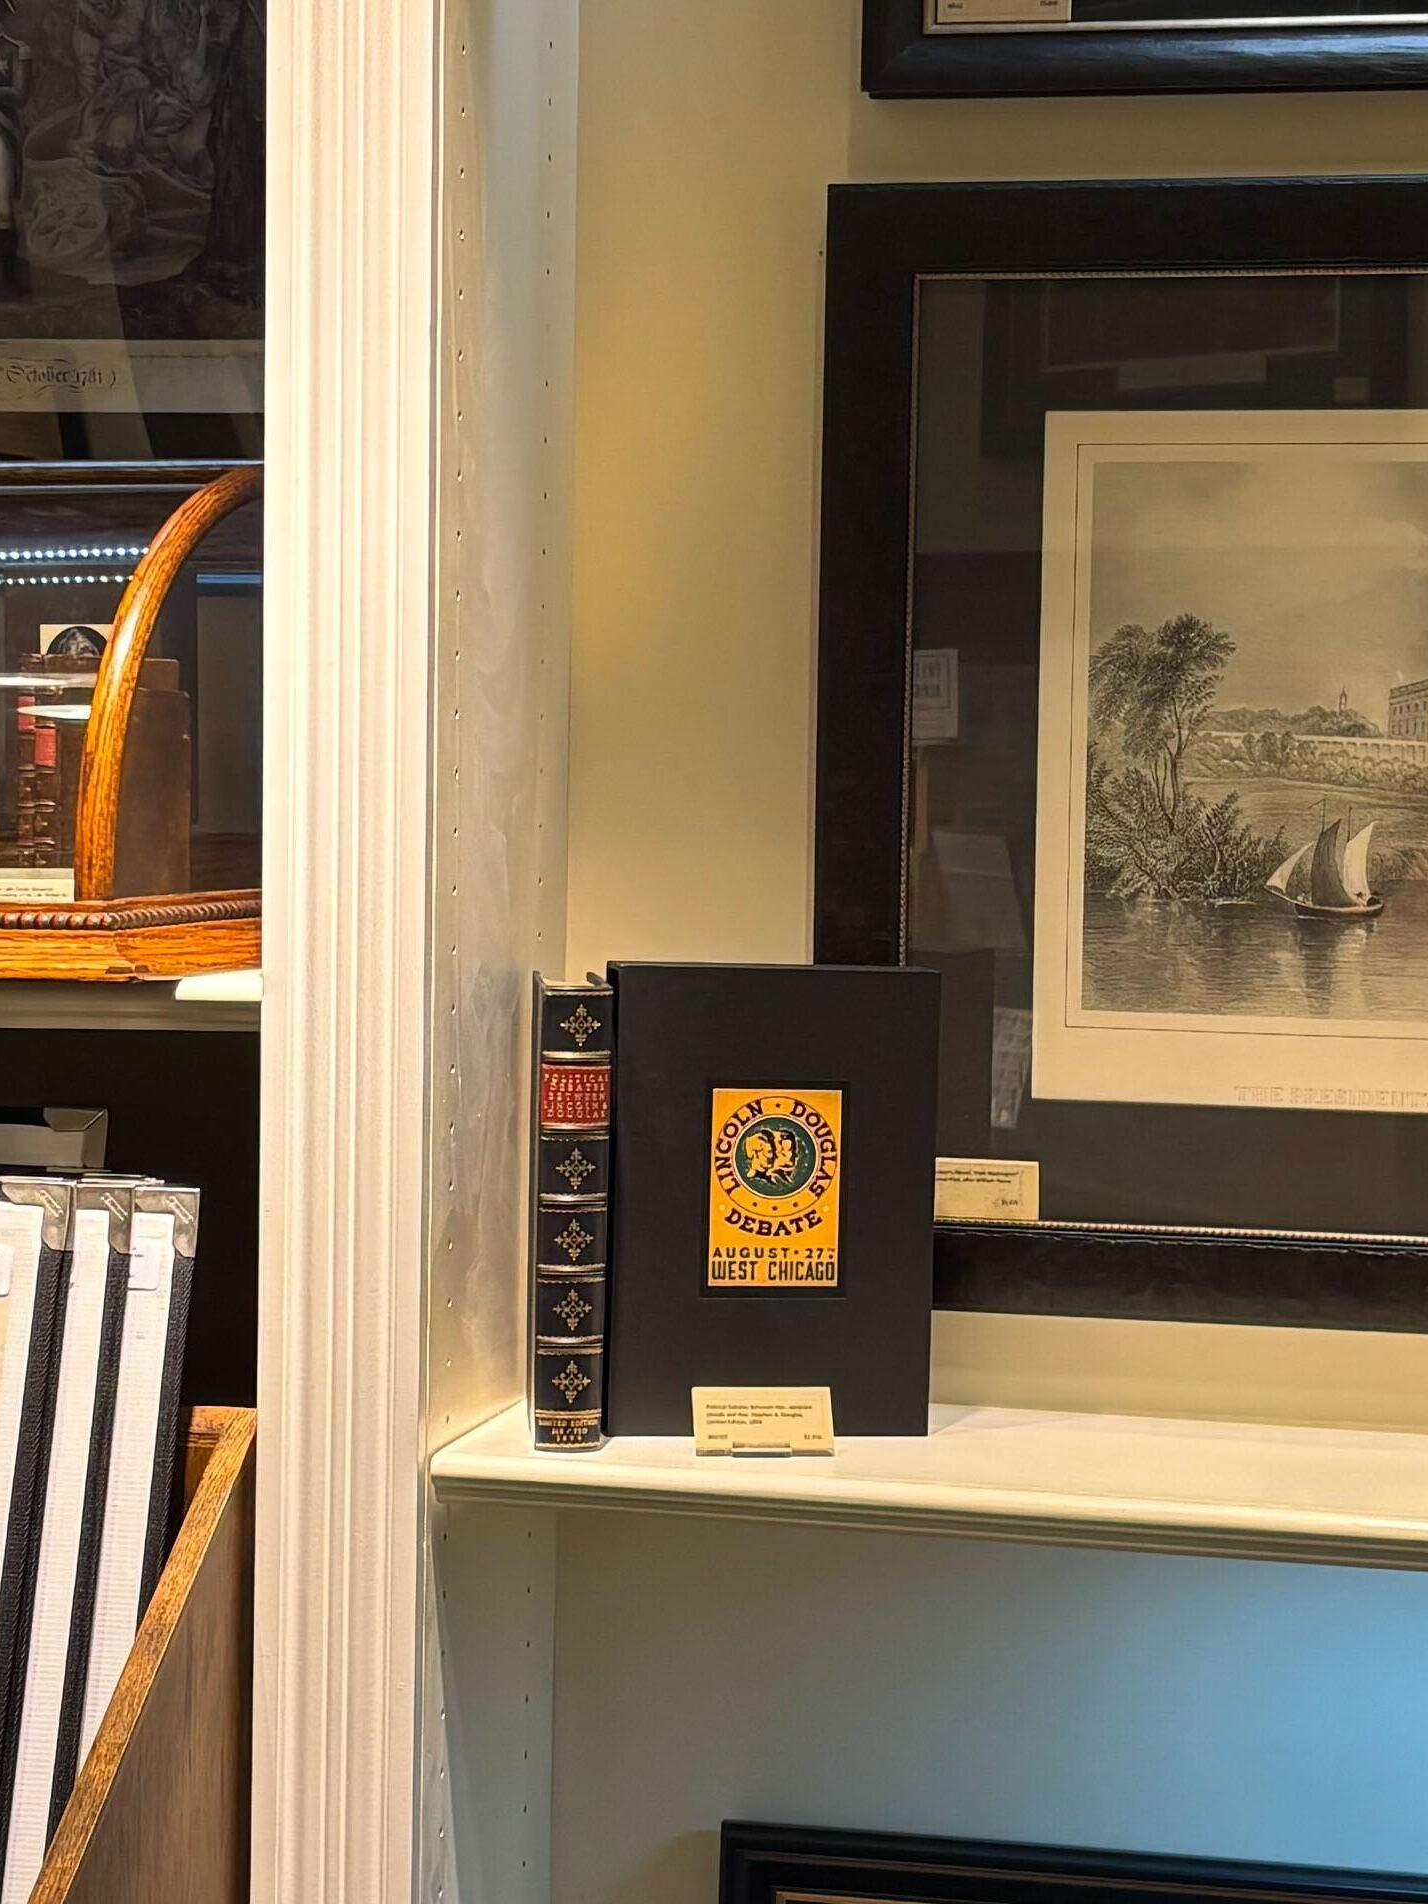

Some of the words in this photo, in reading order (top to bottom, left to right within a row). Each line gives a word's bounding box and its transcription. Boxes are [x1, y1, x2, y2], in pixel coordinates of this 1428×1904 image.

[1233, 1085, 1285, 1105] THE
[714, 1098, 764, 1197] LINCOLN
[790, 1099, 837, 1198] DOUGLAS
[724, 1207, 823, 1237] DEBATE
[712, 1246, 789, 1259] AUGUST
[711, 1260, 759, 1281] WEST
[767, 1260, 836, 1282] CHICAGO
